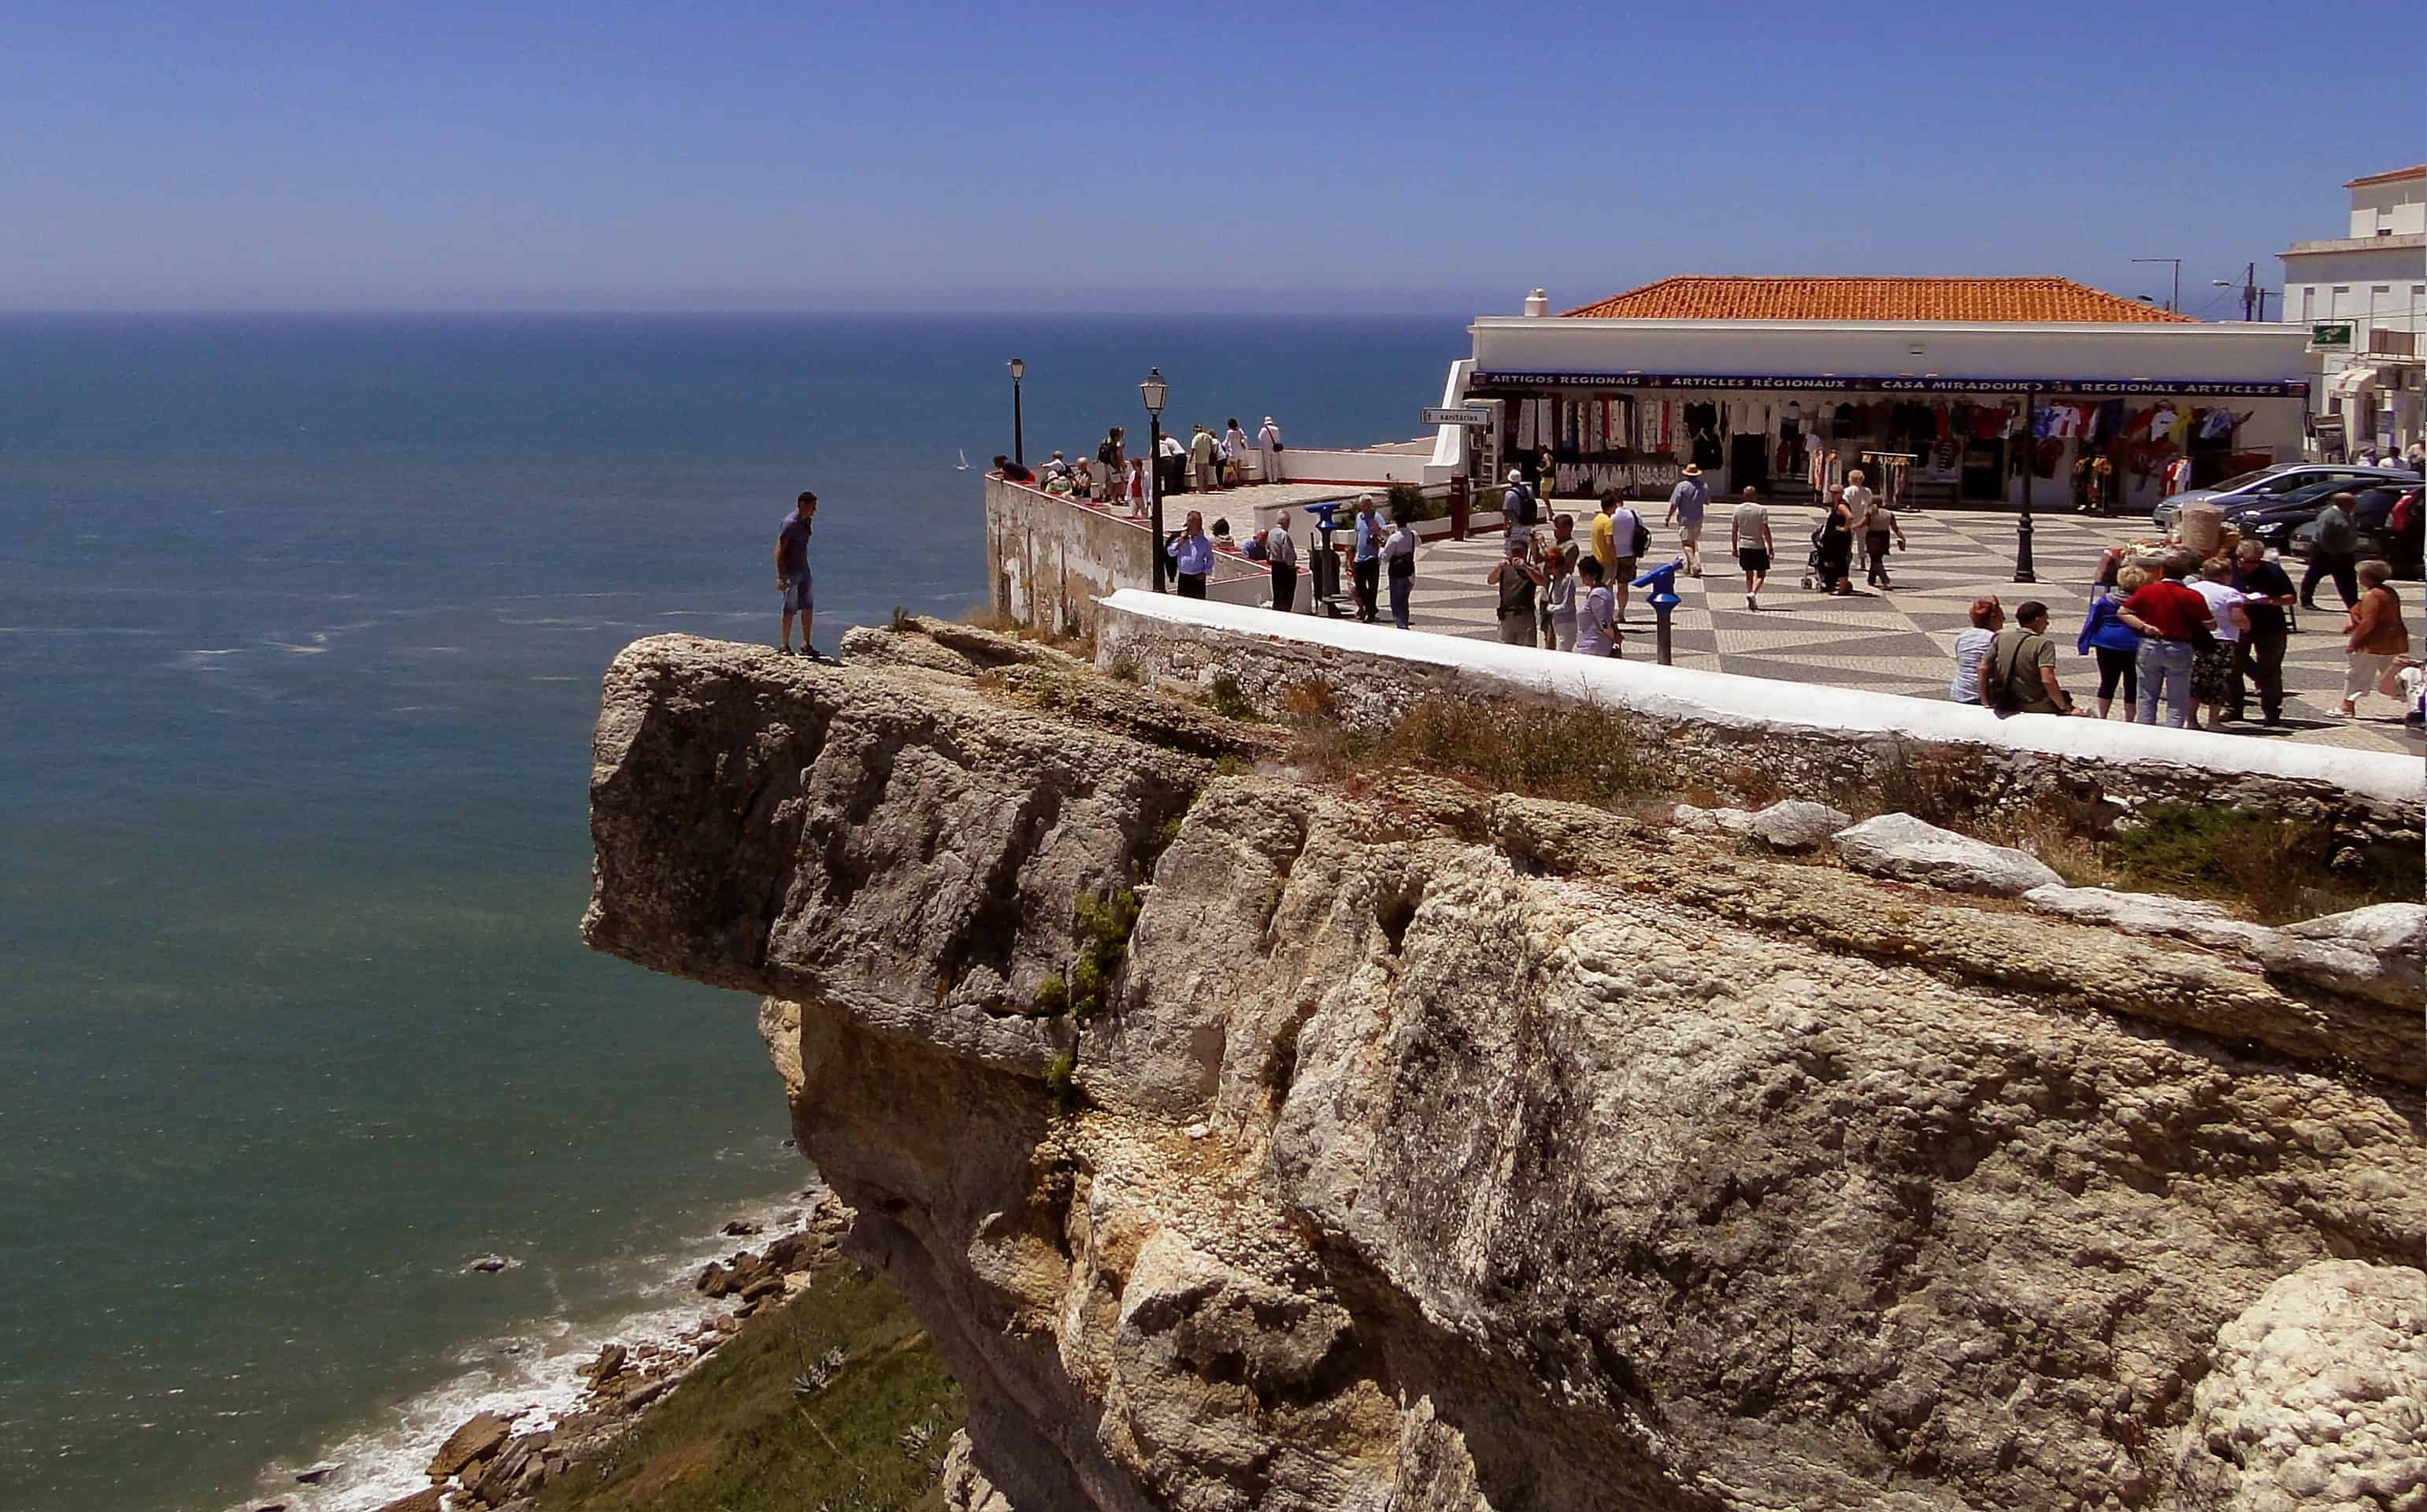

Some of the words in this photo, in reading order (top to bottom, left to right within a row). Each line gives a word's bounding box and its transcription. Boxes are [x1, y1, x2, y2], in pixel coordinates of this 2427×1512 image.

[1491, 375, 1554, 384] ARTIGOS
[1560, 376, 1640, 385] REGIONAIS
[1671, 377, 1746, 387] ARTICLES
[1751, 376, 1847, 388] RÉGIONAUX
[1880, 380, 1925, 390] CASA
[2081, 384, 2177, 393] REGIONAL
[2184, 384, 2281, 394] ARTICLES
